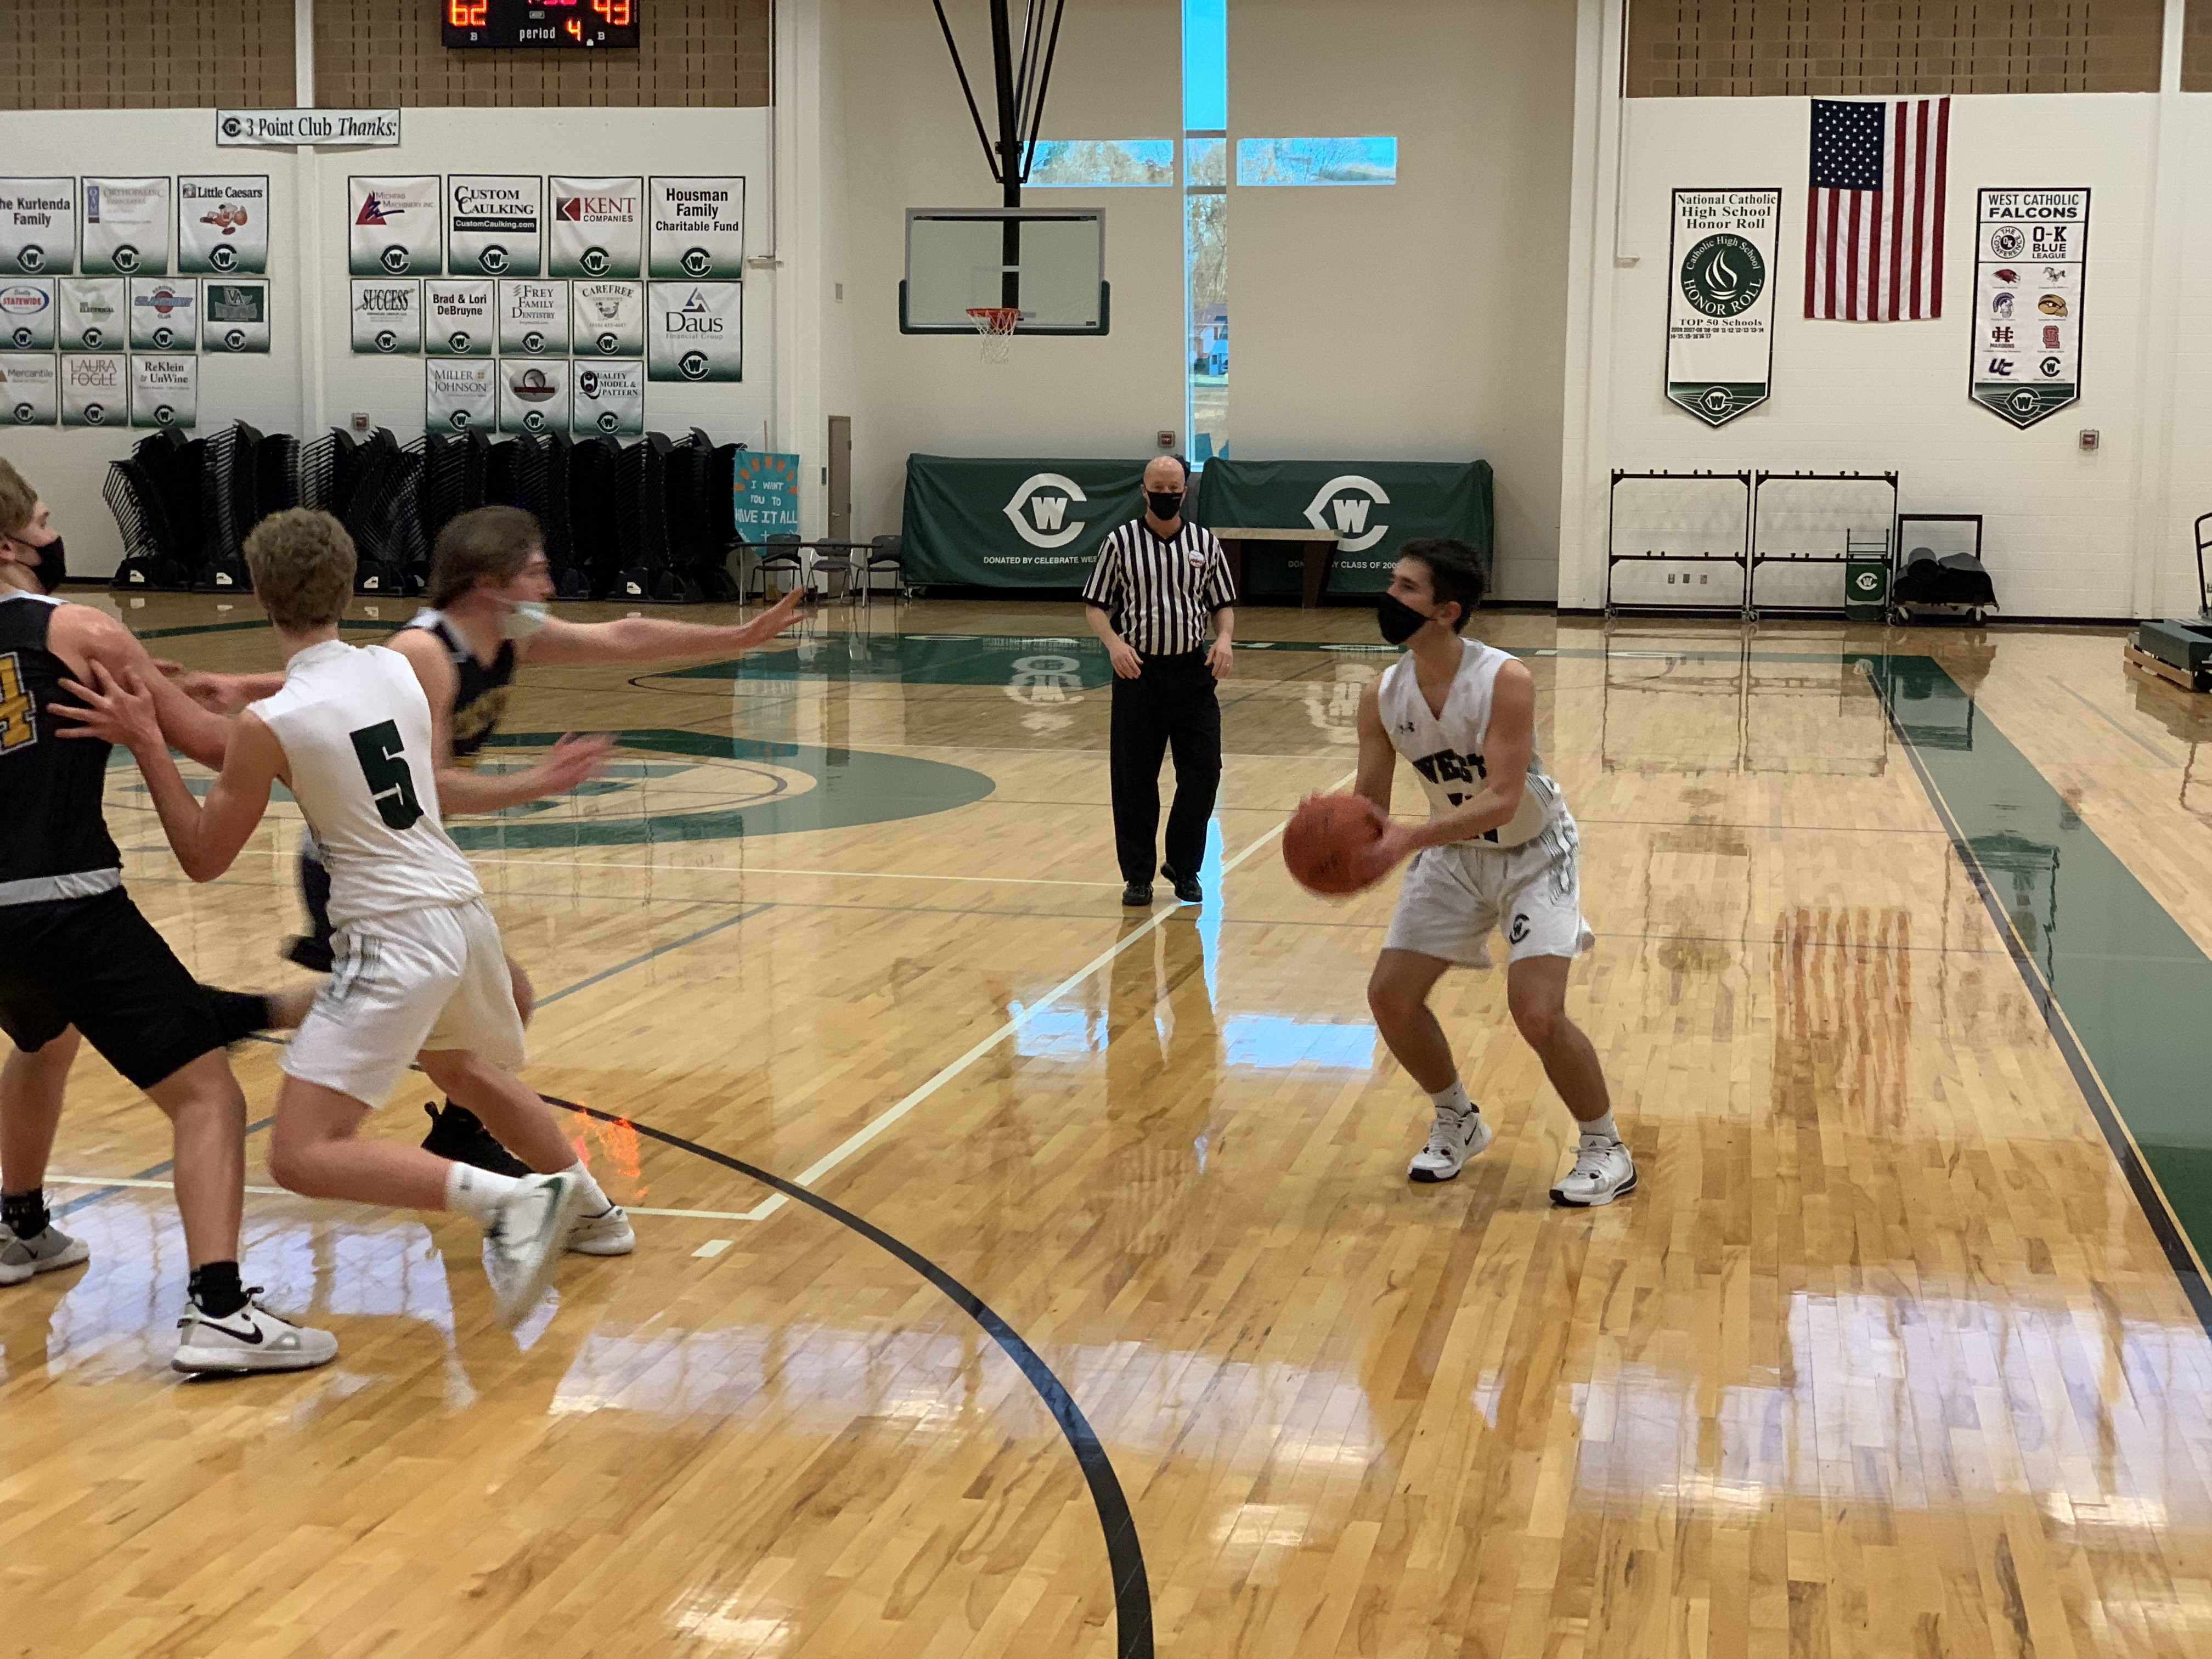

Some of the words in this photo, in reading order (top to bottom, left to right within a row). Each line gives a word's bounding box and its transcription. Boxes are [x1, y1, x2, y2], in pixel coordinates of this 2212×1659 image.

[449, 0, 487, 26] 62
[470, 32, 477, 41] B
[520, 27, 556, 42] period
[567, 19, 582, 42] 4
[597, 31, 605, 40] B
[246, 118, 254, 136] 3
[258, 117, 295, 137] Point
[298, 117, 332, 137] Club
[338, 117, 397, 137] Thanks:
[198, 187, 222, 198] Little
[225, 187, 263, 198] Caesars
[455, 186, 519, 204] CUSTOM
[666, 188, 728, 201] Housman
[0, 198, 13, 210] he
[18, 198, 70, 211] Kurlenda
[458, 196, 534, 215] CAULKING
[584, 197, 636, 214] KENT
[1678, 194, 1725, 205] National
[1729, 194, 1776, 205] Catholic
[1989, 194, 2019, 205] WEST
[2023, 194, 2079, 205] CATHOLIC
[676, 204, 718, 219] Family
[1682, 206, 1716, 219] High
[1723, 206, 1770, 217] School
[1989, 207, 2078, 218] FALCONS
[13, 213, 51, 228] Family
[456, 220, 534, 229] CustomCaulking.com
[656, 221, 709, 231] Charitable
[714, 221, 738, 232] Fund
[1686, 218, 1731, 229] Honor
[1736, 218, 1765, 229] Roll
[2033, 226, 2067, 242] O-K
[1994, 234, 2022, 257] CONFERENCE
[2033, 244, 2066, 252] BLUE
[1686, 240, 1714, 270] Catholic
[1717, 236, 1738, 247] High
[1739, 242, 1760, 269] School
[524, 285, 554, 297] FREY
[583, 285, 634, 298] CAREFREE
[1684, 279, 1726, 315] HONOR
[1730, 279, 1762, 313] ROLL
[363, 289, 409, 311] SUCCESS
[433, 295, 454, 303] Brad
[458, 295, 465, 303] &
[470, 295, 487, 303] Lori
[518, 297, 554, 308] FAMILY
[438, 306, 483, 317] DeBruyne
[512, 307, 555, 319] DENTISTRY
[666, 312, 723, 332] Daus
[71, 359, 117, 373] LAURA
[145, 362, 184, 371] ReKlein
[8, 369, 53, 377] Mercantile
[150, 374, 188, 383] UnWine
[435, 370, 473, 380] MILLER
[435, 381, 487, 393] JOHNSON
[751, 480, 757, 489] I
[763, 482, 783, 490] WANT
[751, 495, 765, 504] YOU
[772, 496, 781, 506] TO
[735, 508, 758, 523] HAVE
[761, 511, 777, 524] IT
[780, 510, 798, 524] ALL
[350, 719, 424, 830] 5
